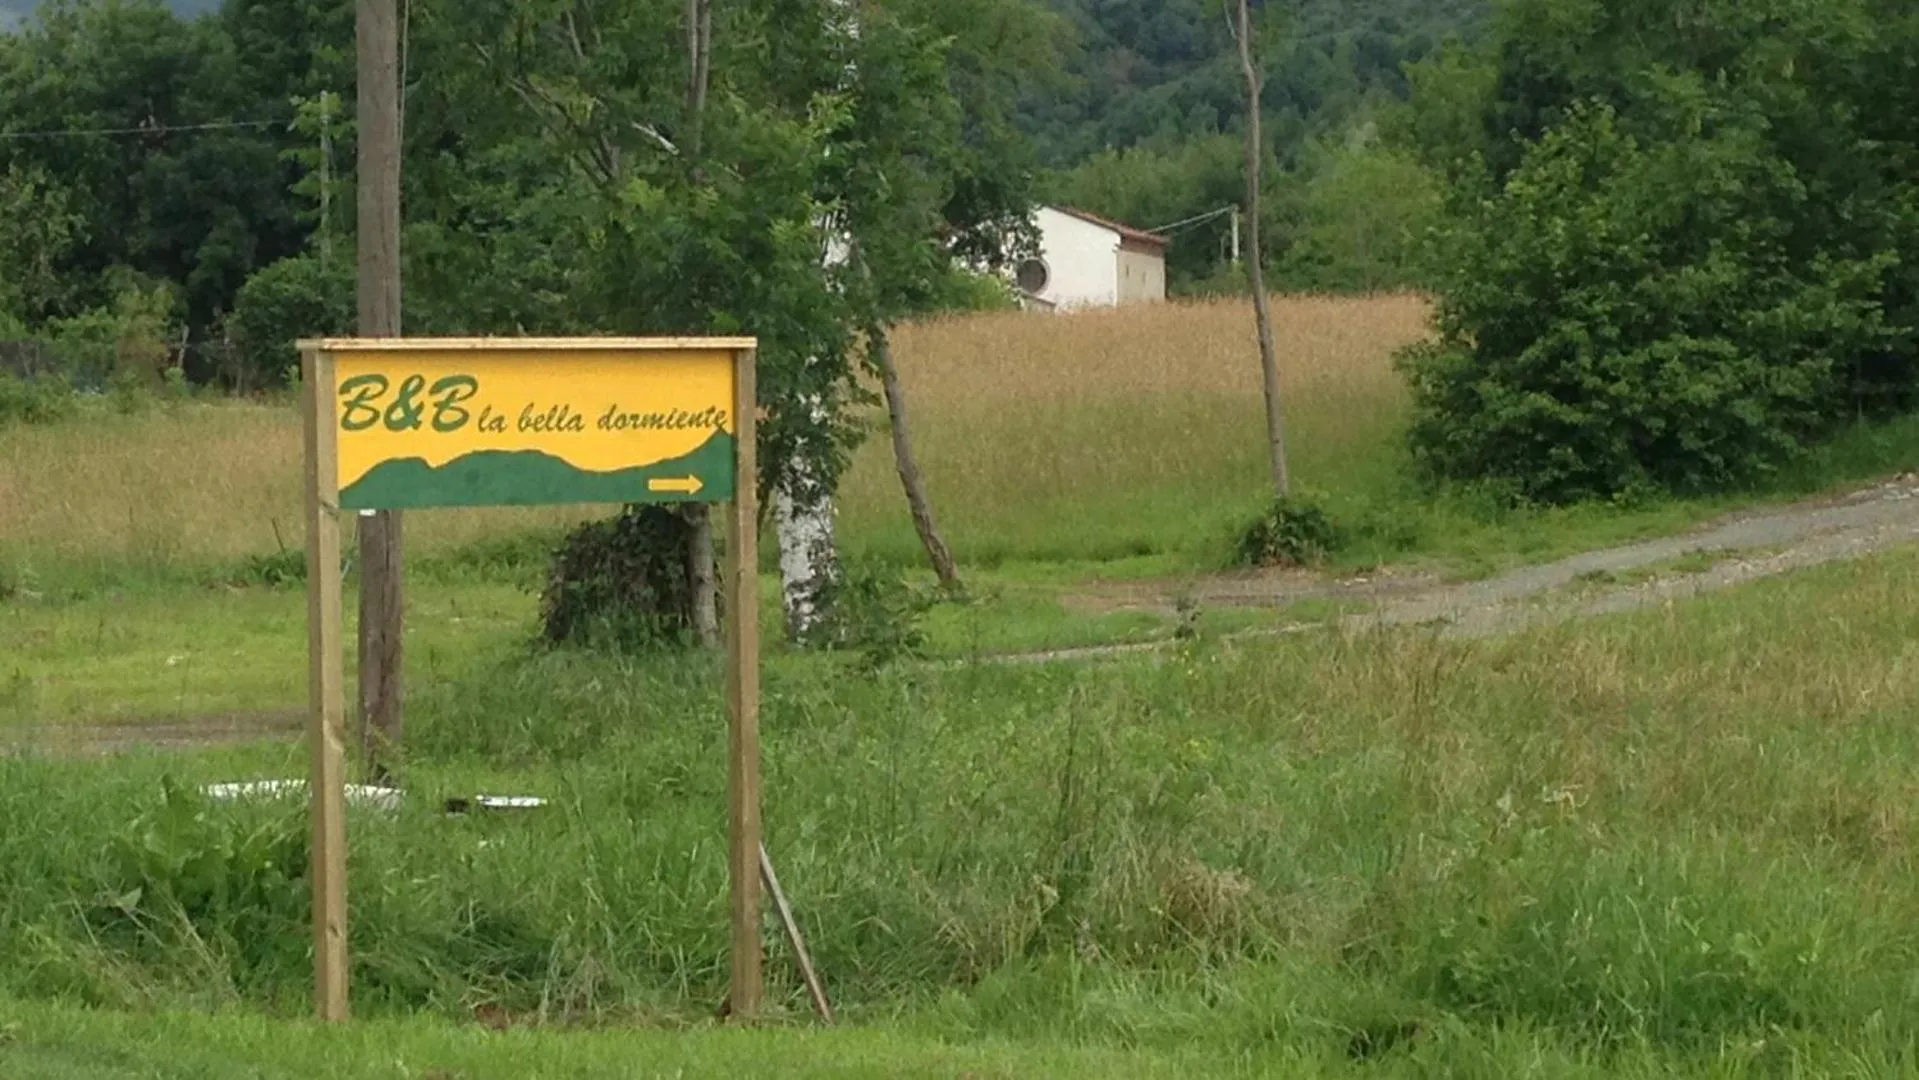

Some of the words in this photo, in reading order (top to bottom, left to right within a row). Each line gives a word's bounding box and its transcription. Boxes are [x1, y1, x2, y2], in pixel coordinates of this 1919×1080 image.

[338, 373, 478, 432] B&B
[478, 404, 508, 433] la
[518, 403, 584, 433] bella
[597, 403, 729, 431] dormiente
